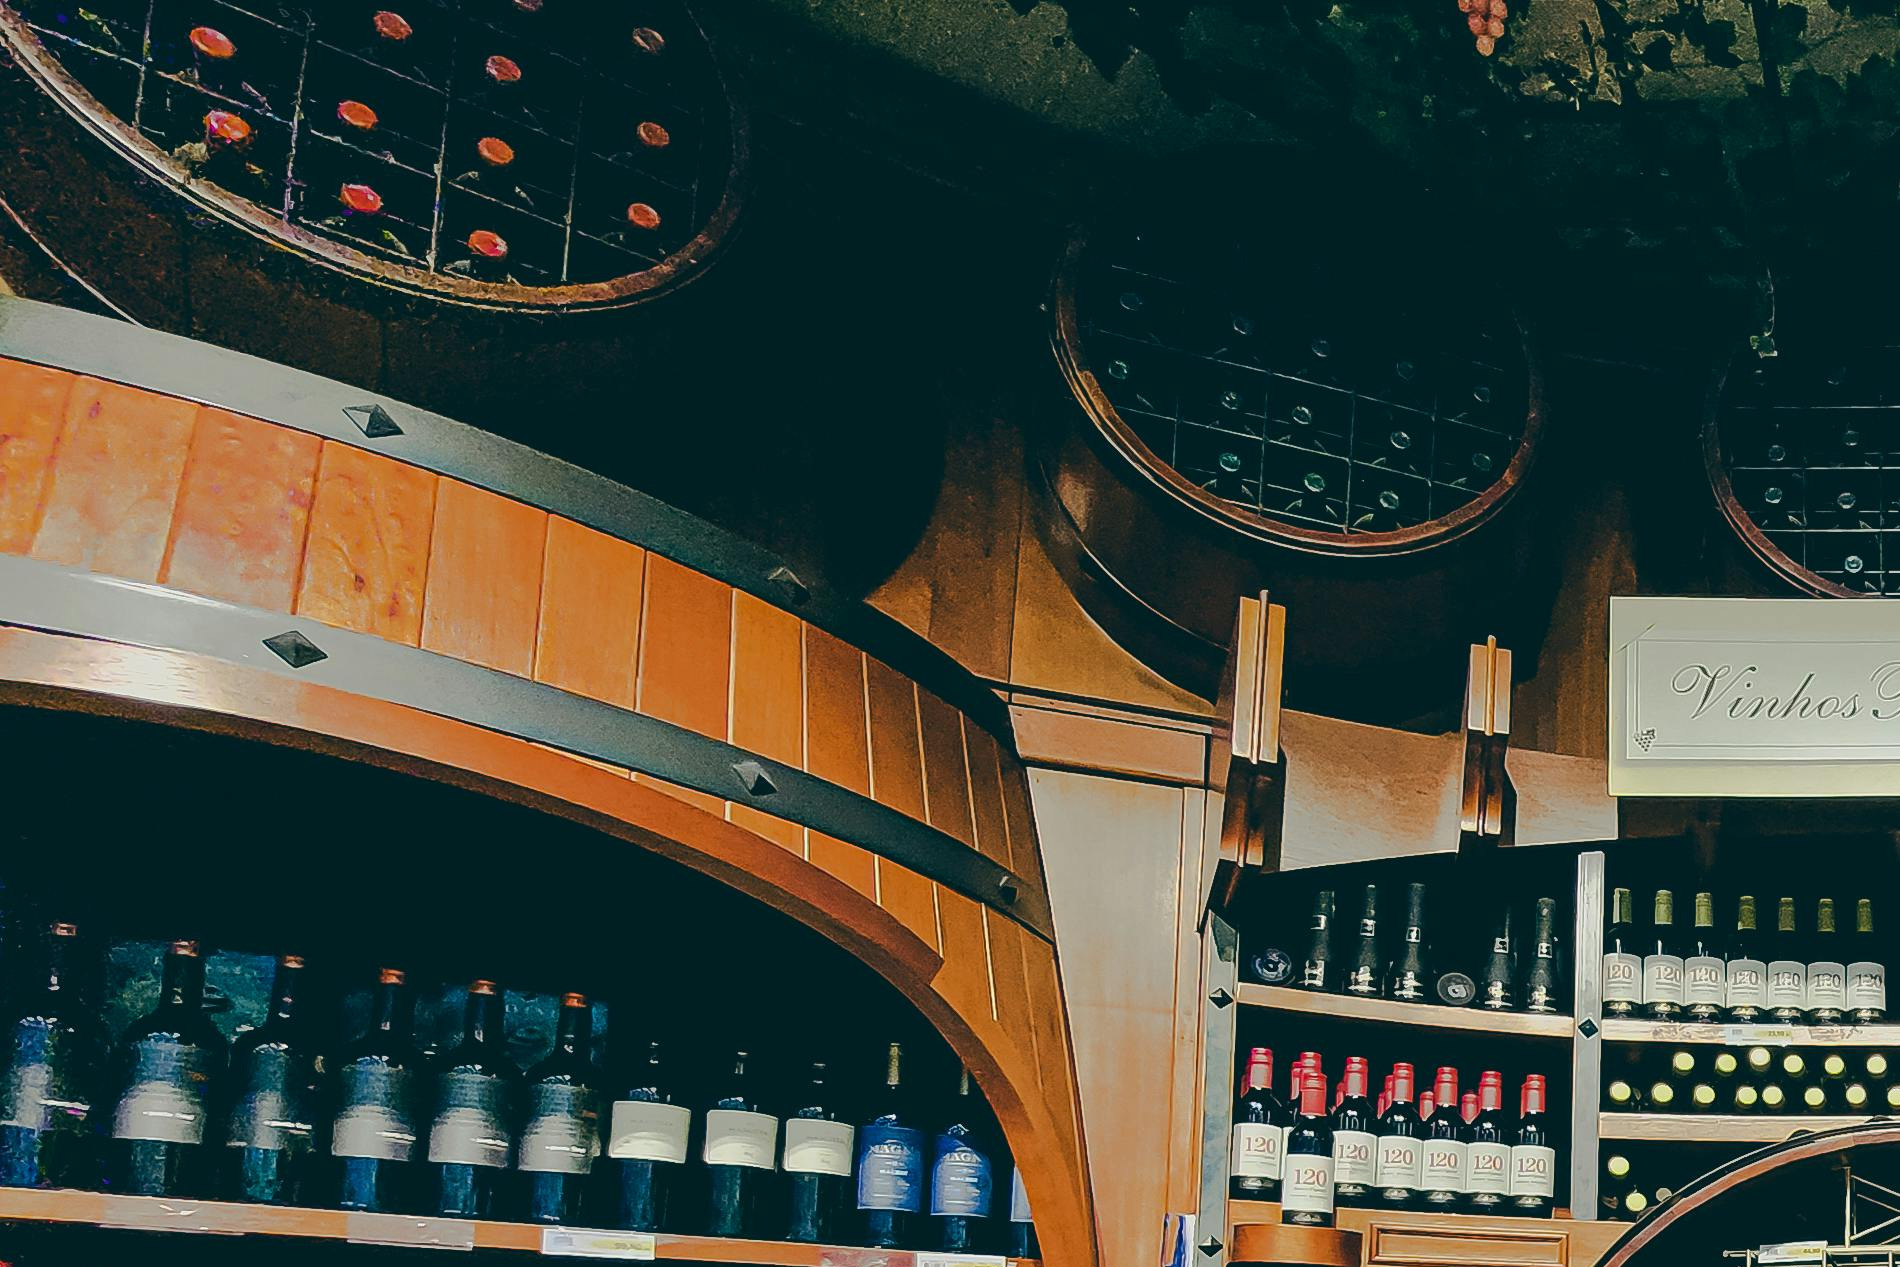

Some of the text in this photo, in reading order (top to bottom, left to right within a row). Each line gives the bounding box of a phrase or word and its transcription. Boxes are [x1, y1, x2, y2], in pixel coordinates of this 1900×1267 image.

[1671, 664, 1863, 721] Vinhos
[1655, 965, 1681, 984] 120
[1690, 967, 1720, 985] 120
[1731, 970, 1759, 988] 120
[1773, 971, 1800, 988] 120
[1814, 974, 1840, 989] 120
[1856, 974, 1882, 988] 120
[1245, 1137, 1277, 1153] 120
[1337, 1143, 1369, 1160] 120
[1384, 1149, 1413, 1166] 120
[1428, 1152, 1458, 1168] 120
[1473, 1154, 1503, 1170] 120
[1517, 1157, 1547, 1174] 120
[1294, 1168, 1327, 1186] 120
